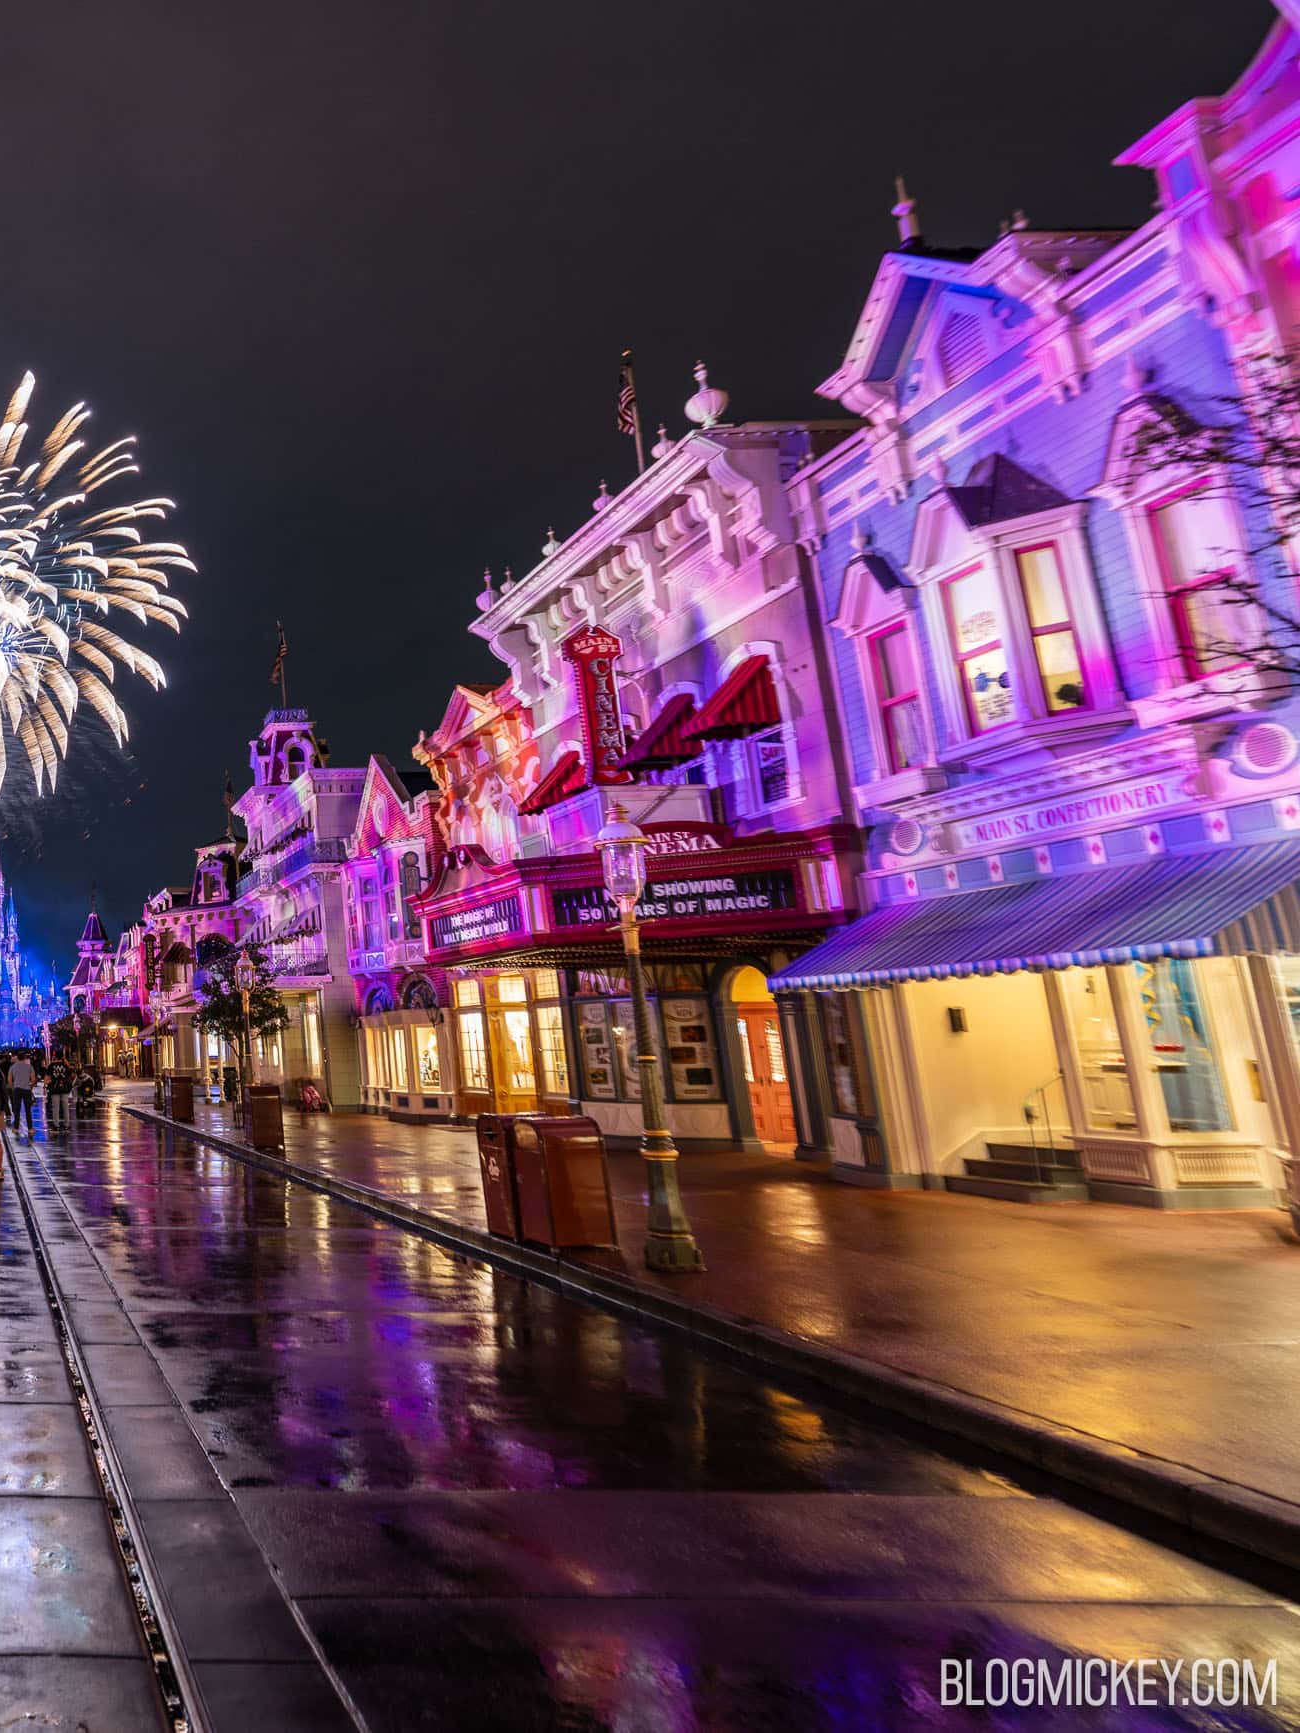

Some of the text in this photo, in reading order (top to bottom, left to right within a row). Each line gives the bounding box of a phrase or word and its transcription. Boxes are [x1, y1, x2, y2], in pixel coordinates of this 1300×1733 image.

[589, 658, 621, 765] CINEMA
[976, 819, 1012, 842] MAIN
[1037, 783, 1168, 829] CONFECTIONERY
[642, 834, 722, 855] NEMA
[646, 832, 671, 843] AIN
[652, 878, 736, 898] SHOWING
[579, 895, 770, 921] 50 YARS OF MAGIC
